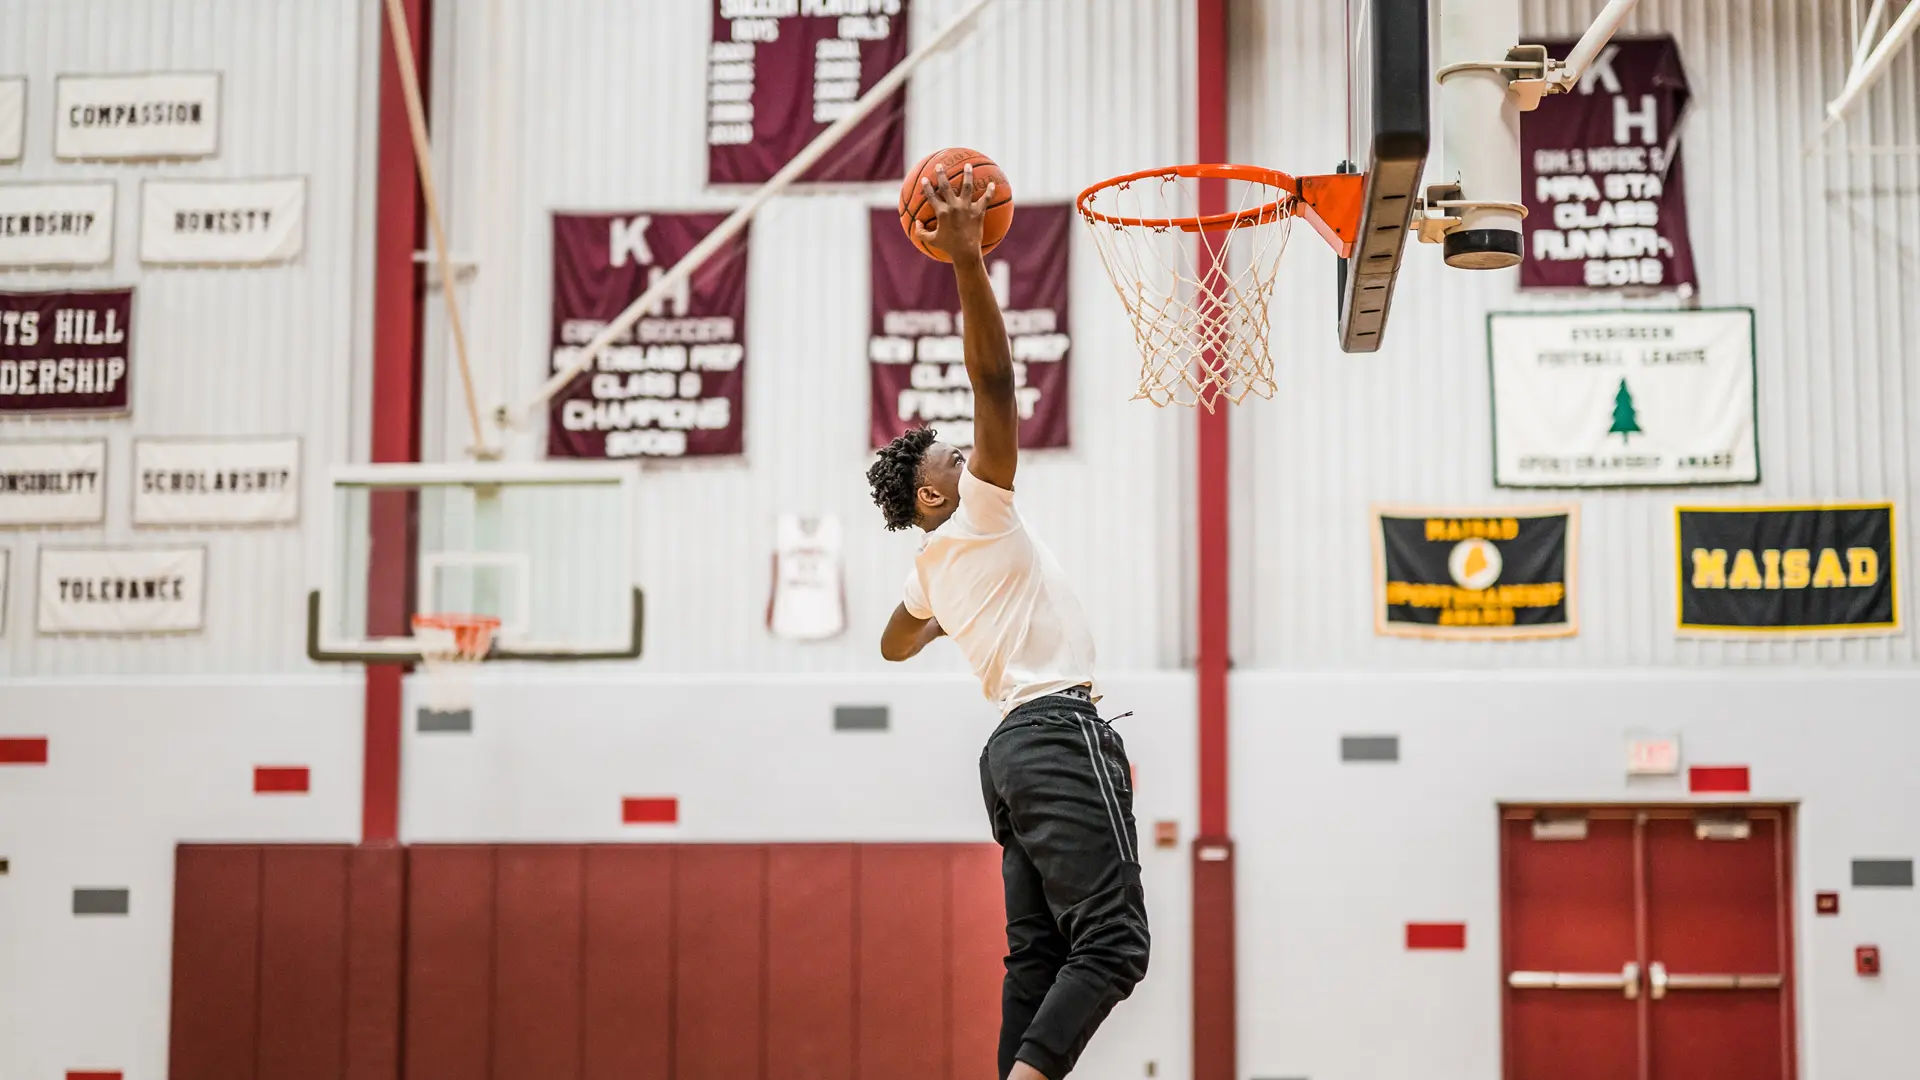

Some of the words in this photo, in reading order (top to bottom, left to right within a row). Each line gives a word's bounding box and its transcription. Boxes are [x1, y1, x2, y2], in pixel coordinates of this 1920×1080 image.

[70, 102, 203, 127] COMPASSION
[1613, 94, 1657, 144] H
[1536, 175, 1600, 202] MPA
[174, 210, 271, 233] HONESTY
[1554, 201, 1658, 229] CLASS
[610, 216, 652, 267] K
[0, 310, 40, 346] TS
[54, 309, 123, 344] HILL
[638, 317, 734, 343] SOCCER
[884, 311, 949, 336] BOYS
[1573, 327, 1673, 342] EVERGREEN
[597, 346, 687, 371] ENGLAND
[690, 343, 743, 370] PREP
[870, 337, 914, 363] NEW
[1014, 333, 1070, 362] PREP
[0, 358, 124, 394] DERSHIP
[592, 372, 676, 398] CLASS
[563, 398, 730, 430] CHAMPIONS
[143, 470, 289, 493] SCHOLARSHIP
[1425, 518, 1518, 540] MAISAD
[1692, 547, 1878, 589] MAISAD
[59, 577, 183, 601] TOLERANCE
